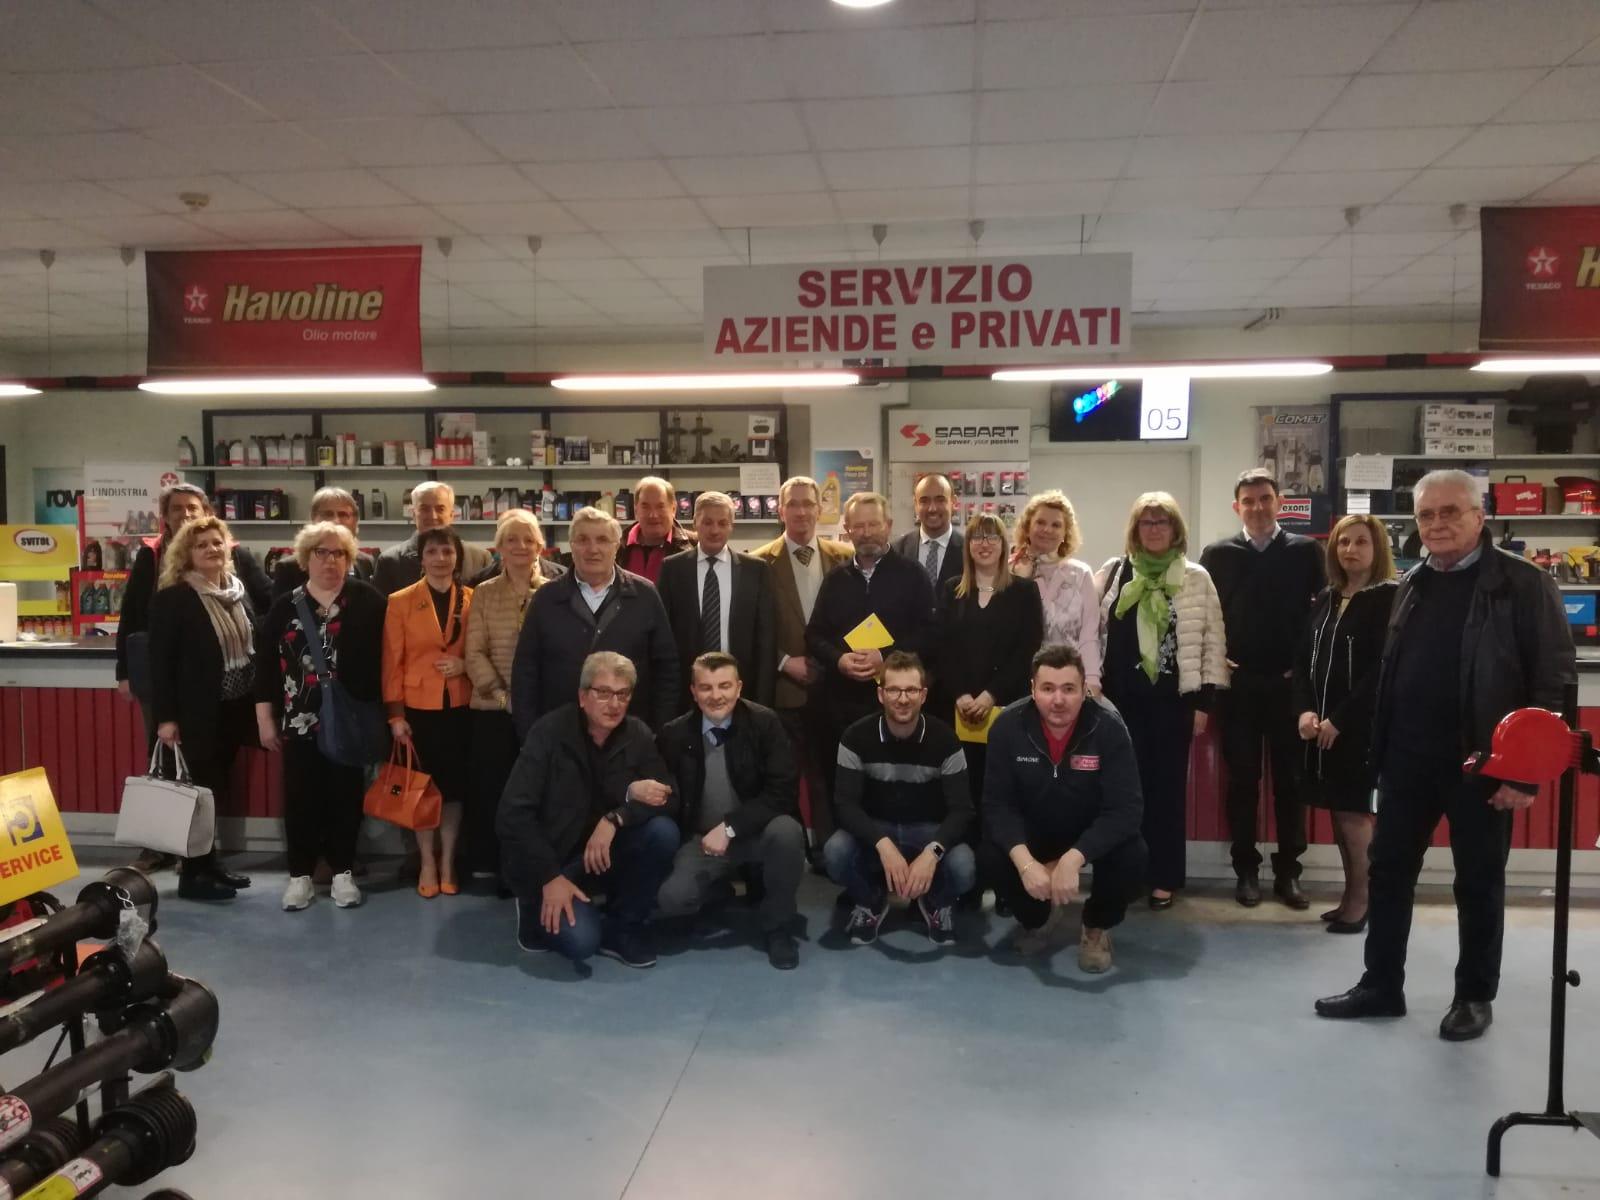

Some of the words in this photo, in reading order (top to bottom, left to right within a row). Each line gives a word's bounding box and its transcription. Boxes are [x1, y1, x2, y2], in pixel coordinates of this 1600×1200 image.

[798, 263, 1032, 308] SERVIZIO
[222, 283, 383, 321] Havoline
[303, 329, 329, 341] Olio
[332, 330, 377, 341] motore
[714, 314, 896, 354] AZIENDE
[912, 322, 935, 350] e
[951, 307, 1120, 349] PRIVATI
[1147, 408, 1182, 430] 05
[935, 426, 1019, 437] SABART
[21, 537, 50, 546] SVITOL
